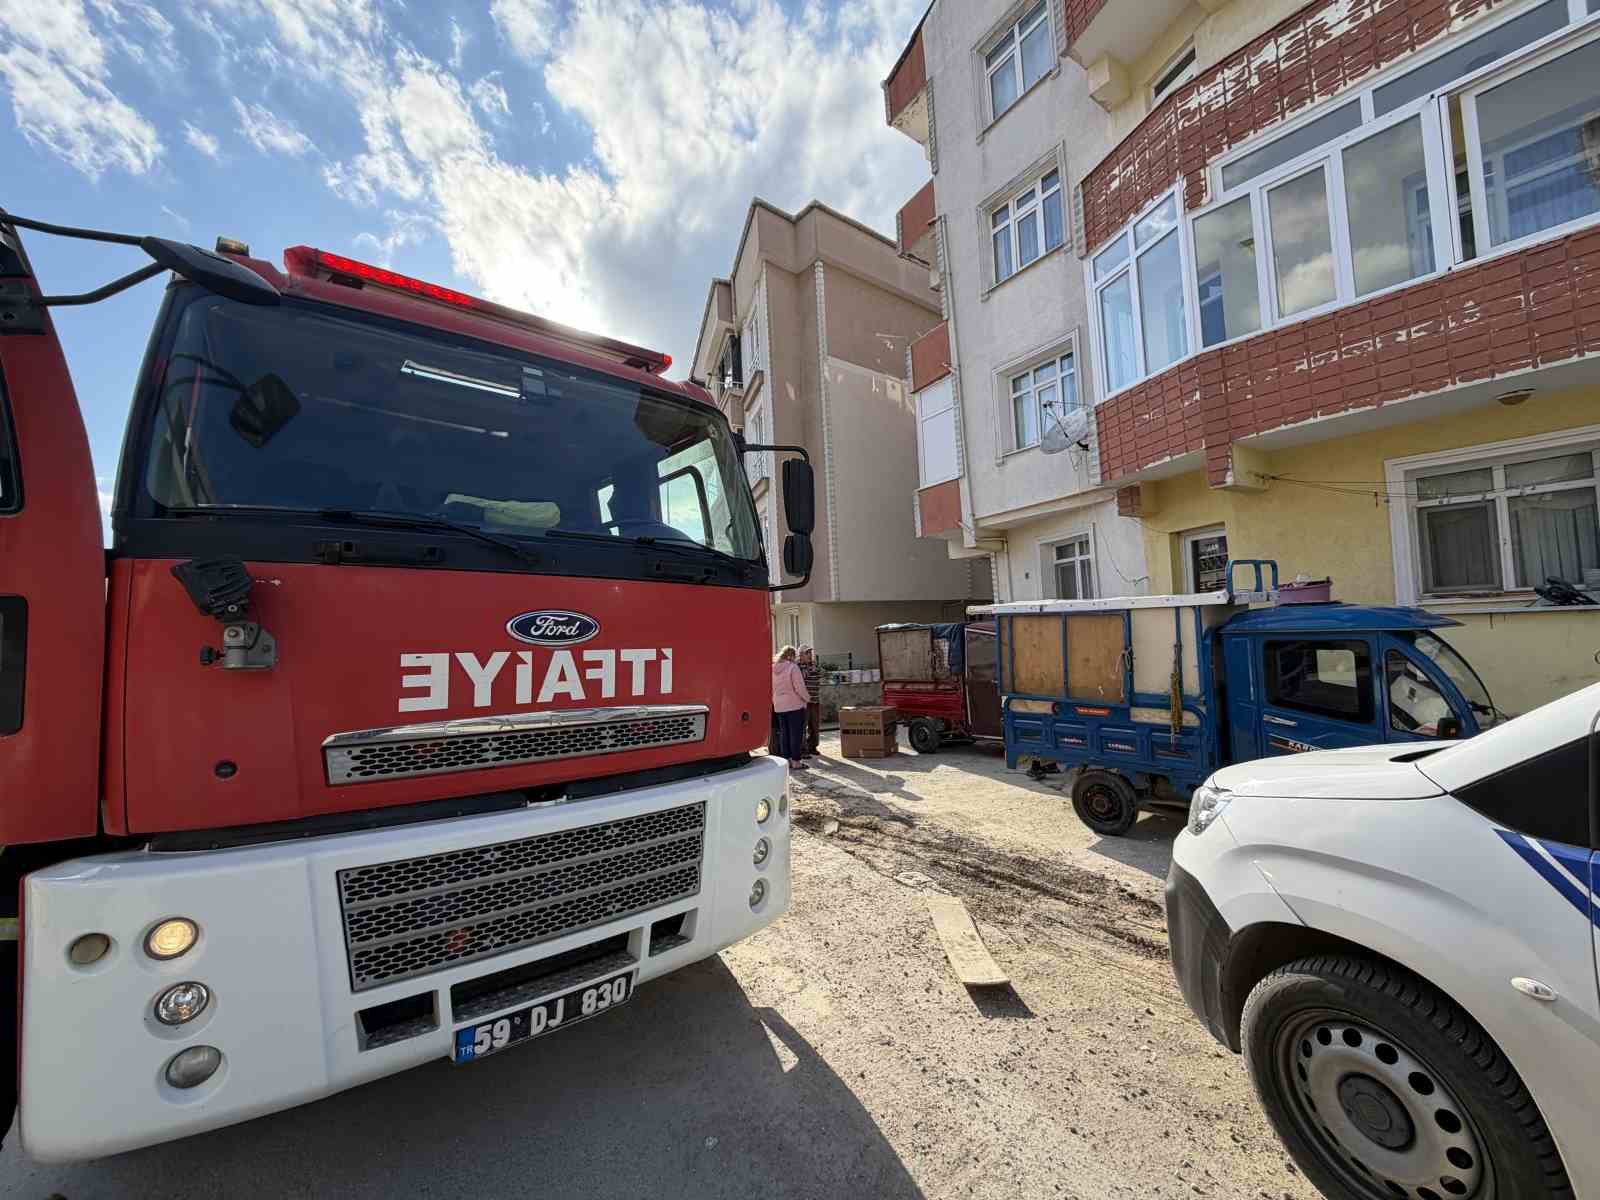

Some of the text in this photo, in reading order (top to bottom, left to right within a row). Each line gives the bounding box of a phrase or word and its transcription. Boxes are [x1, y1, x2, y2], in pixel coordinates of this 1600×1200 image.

[530, 615, 580, 637] Ford
[460, 977, 626, 1056] TR 59 DJ 830
